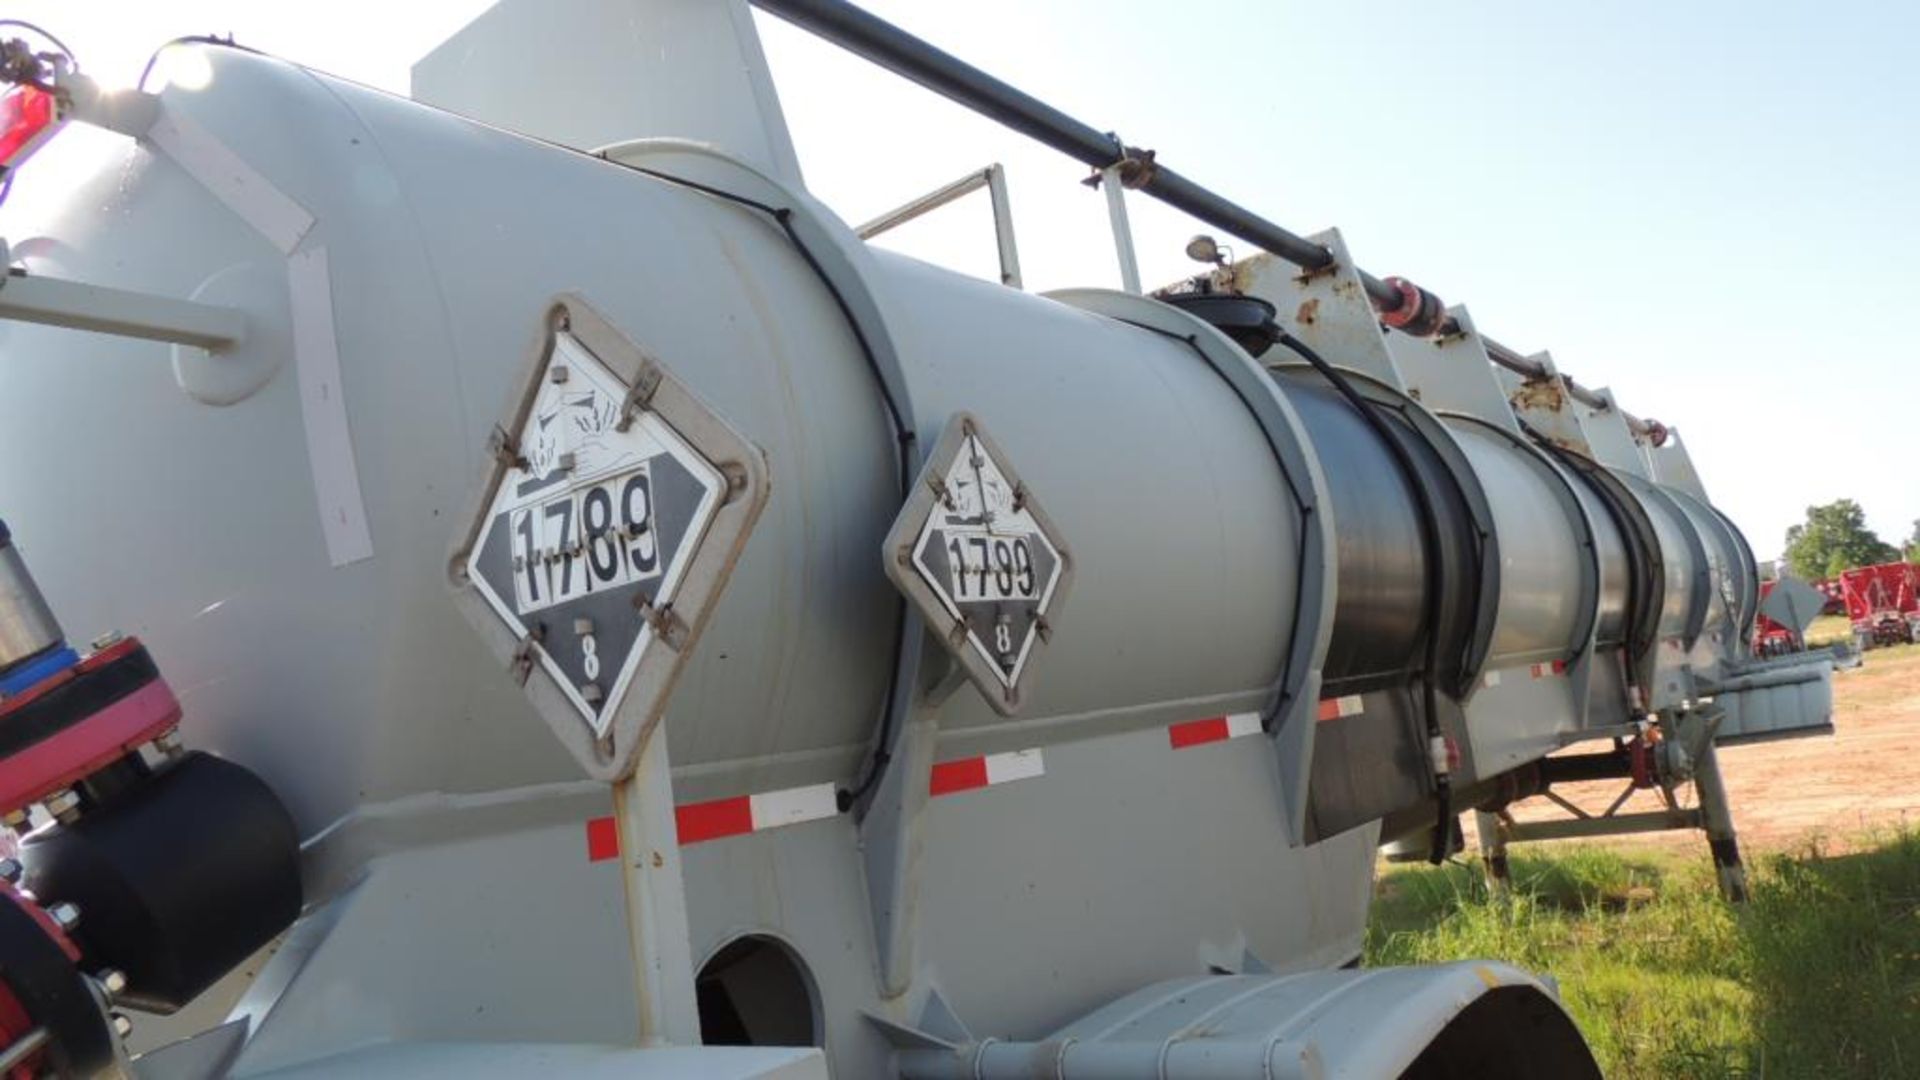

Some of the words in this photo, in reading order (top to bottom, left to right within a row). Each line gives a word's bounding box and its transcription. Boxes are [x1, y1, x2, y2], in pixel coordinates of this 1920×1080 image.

[516, 473, 658, 602] 1789
[949, 537, 1035, 598] 1789
[581, 633, 599, 682] 8
[995, 623, 1011, 653] 8
